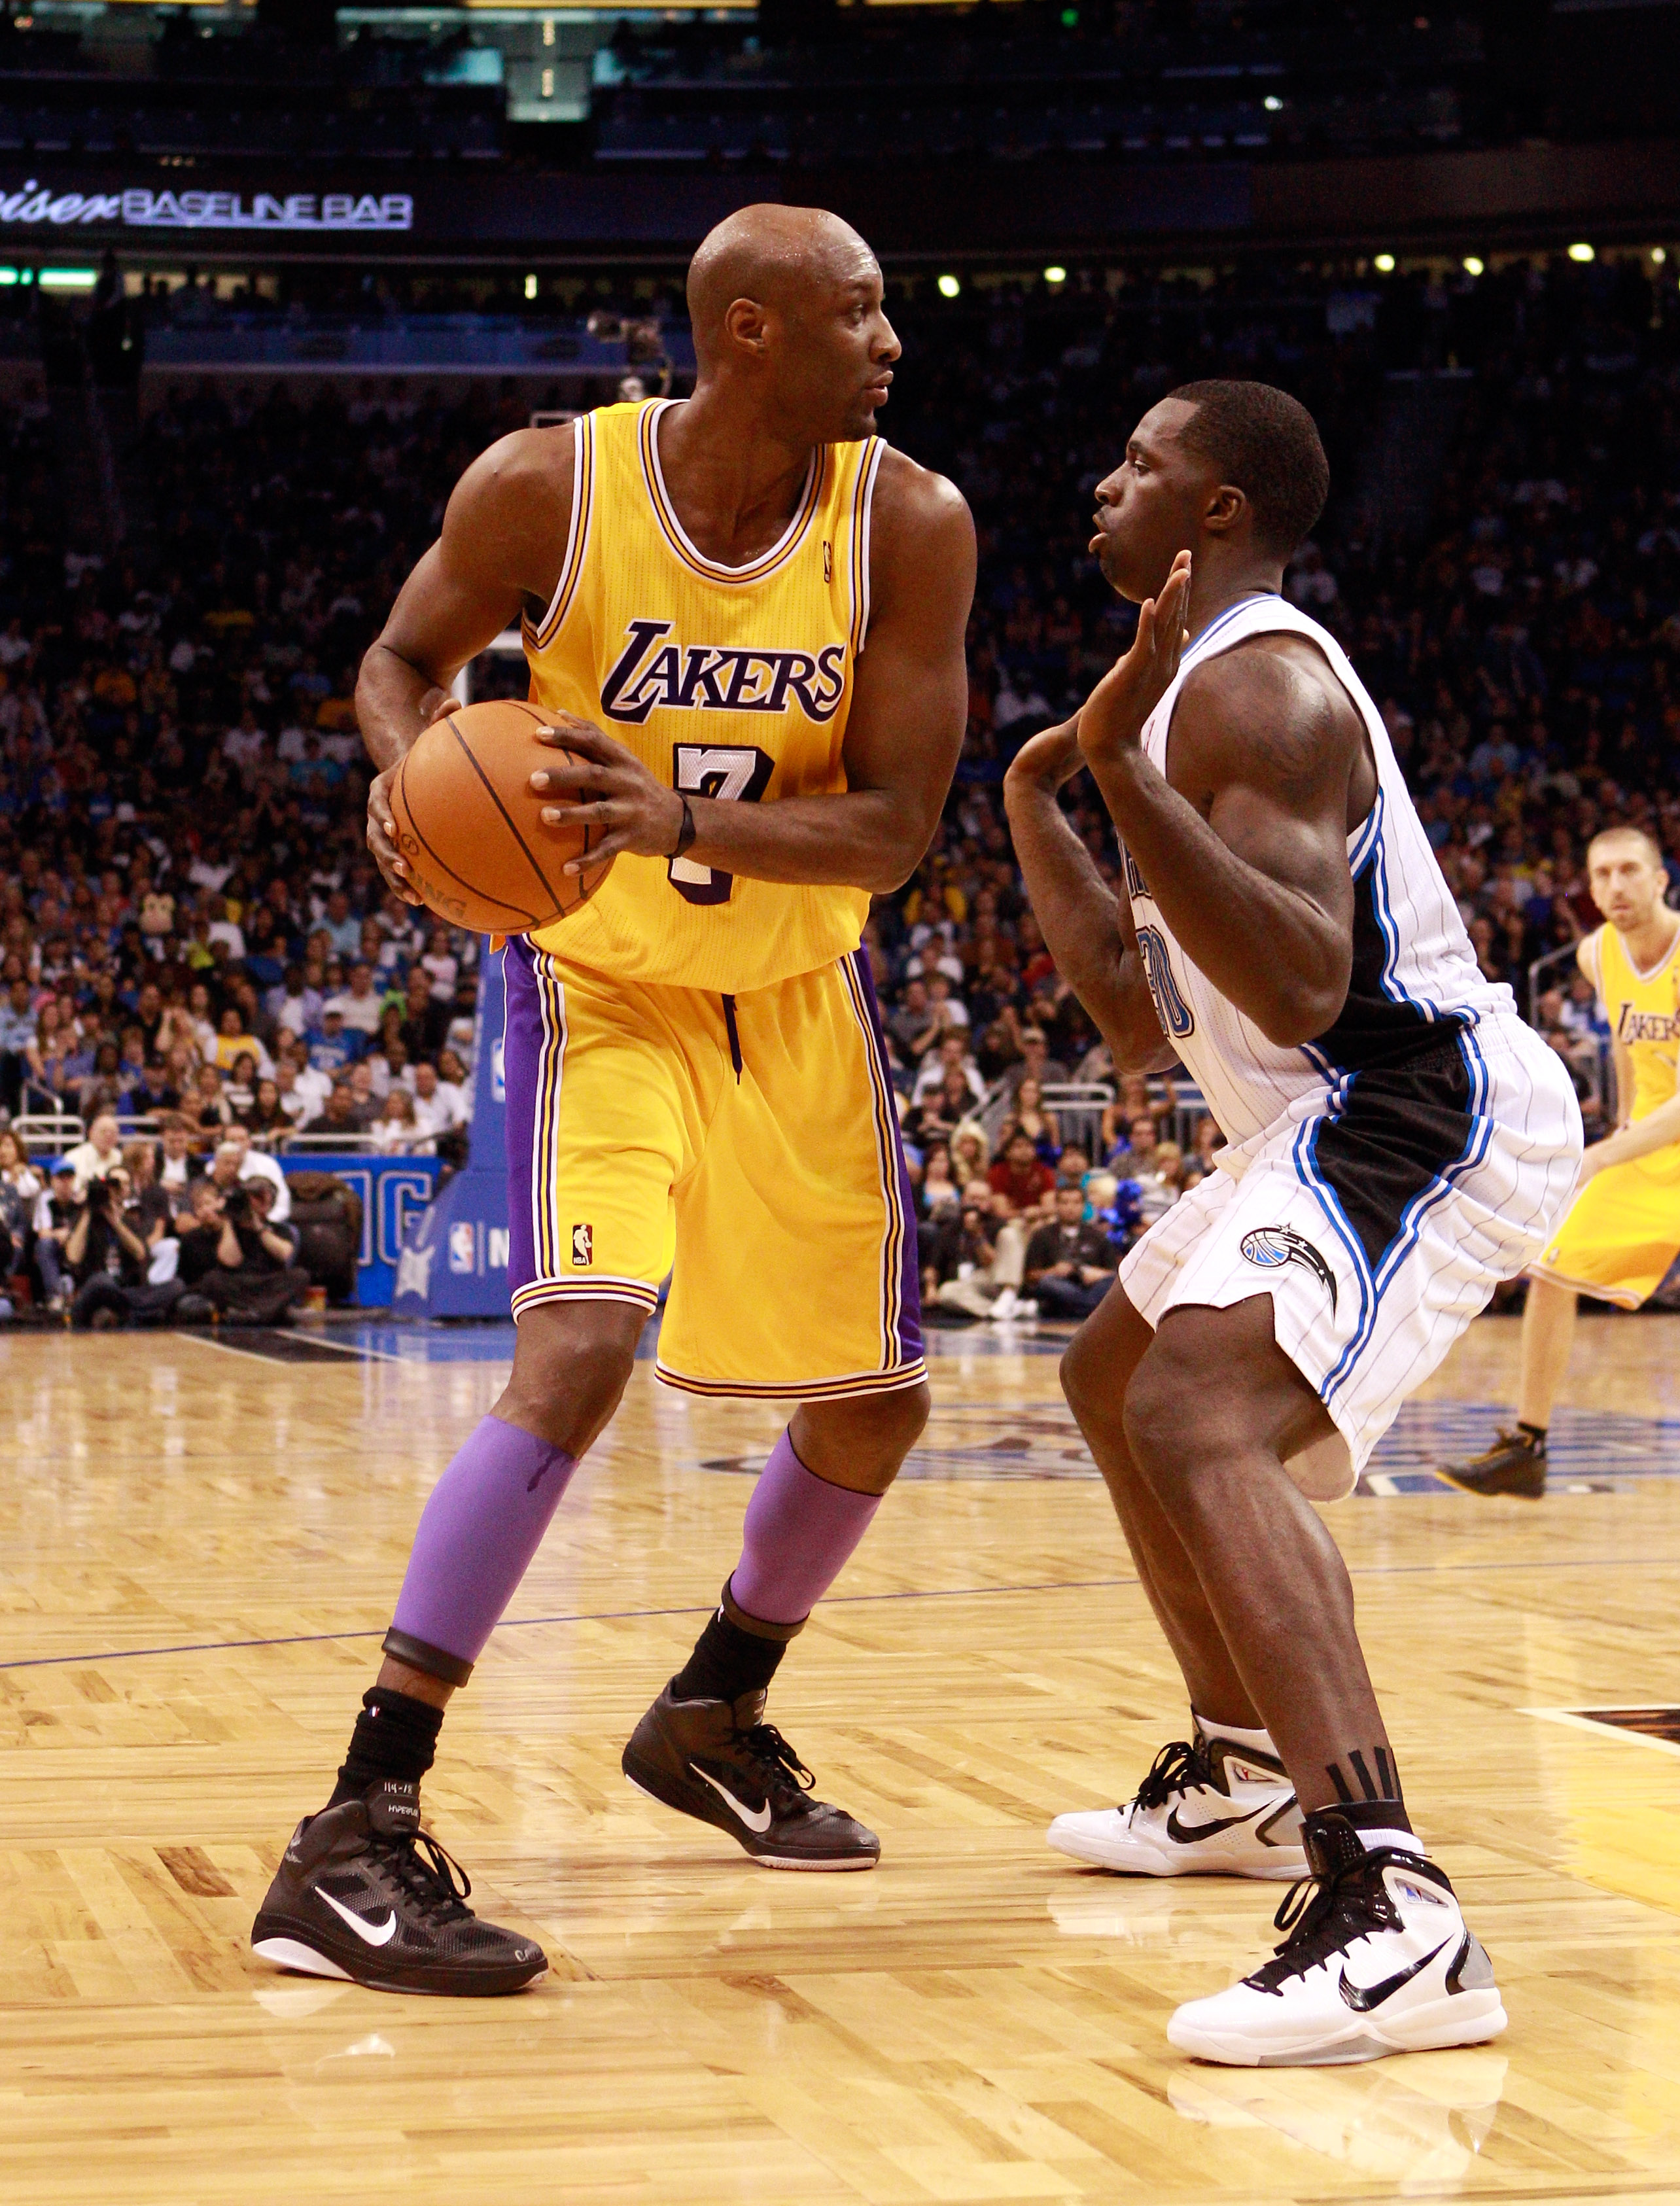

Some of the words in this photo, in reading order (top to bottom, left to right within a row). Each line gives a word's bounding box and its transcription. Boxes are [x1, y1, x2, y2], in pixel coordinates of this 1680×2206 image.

[0, 179, 122, 224] iser
[122, 188, 317, 226] BASELINE
[322, 194, 413, 229] BAR
[600, 618, 847, 725] LAKERS
[667, 743, 775, 905] 7
